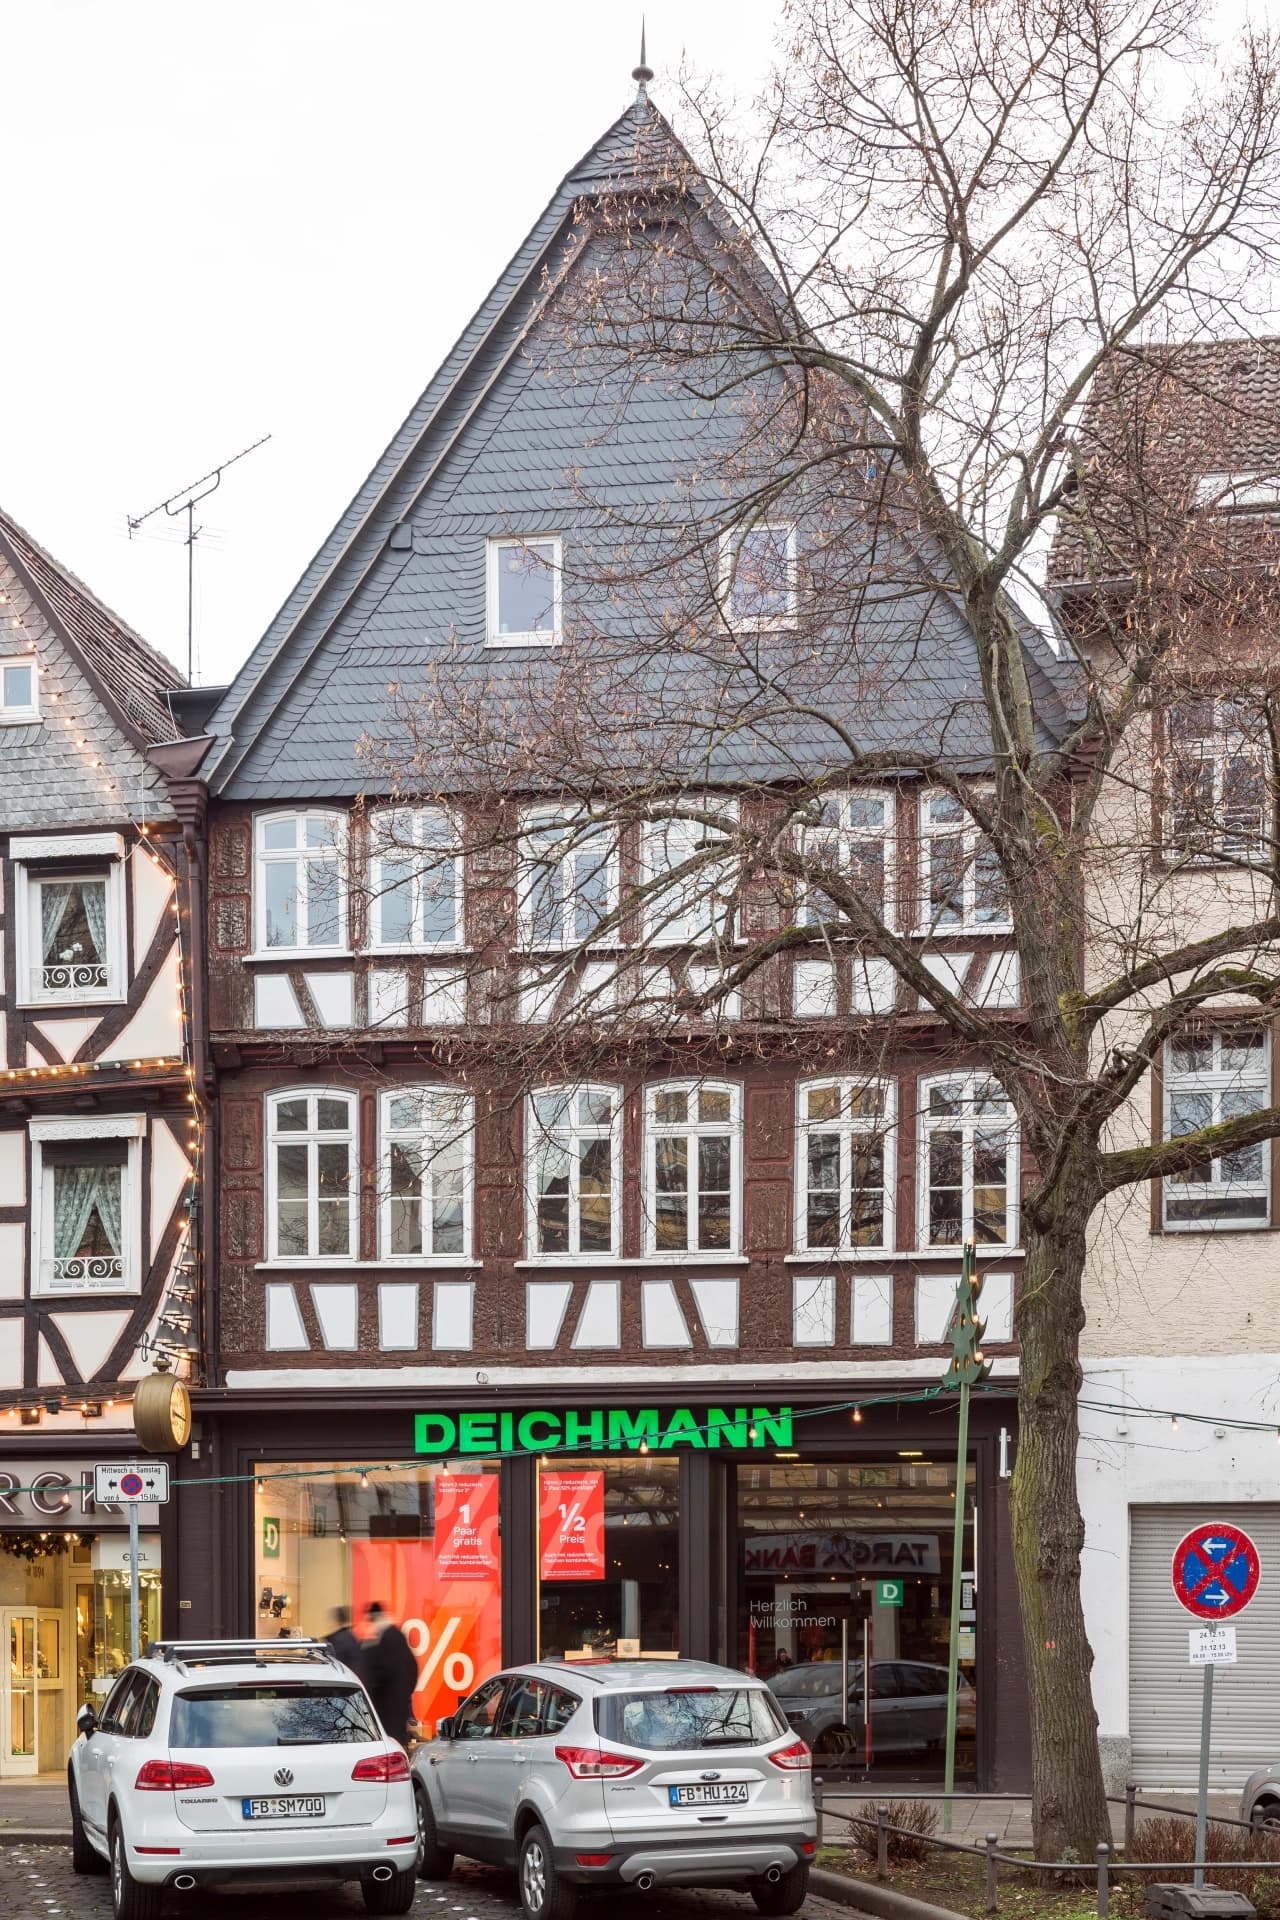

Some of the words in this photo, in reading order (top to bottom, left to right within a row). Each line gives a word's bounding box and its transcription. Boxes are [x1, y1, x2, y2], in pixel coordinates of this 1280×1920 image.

[414, 1407, 793, 1453] DEICHMANN
[150, 1493, 160, 1501] Uhr
[459, 1503, 470, 1524] 1
[453, 1526, 477, 1536] Paar
[453, 1537, 482, 1548] gratis
[559, 1534, 585, 1544] Preis
[122, 1553, 149, 1562] EEL
[882, 1583, 898, 1599] D
[750, 1599, 807, 1612] Herzlich
[679, 1787, 695, 1801] FB
[703, 1785, 720, 1800] HU
[722, 1785, 746, 1799] 124
[252, 1801, 269, 1814] FB
